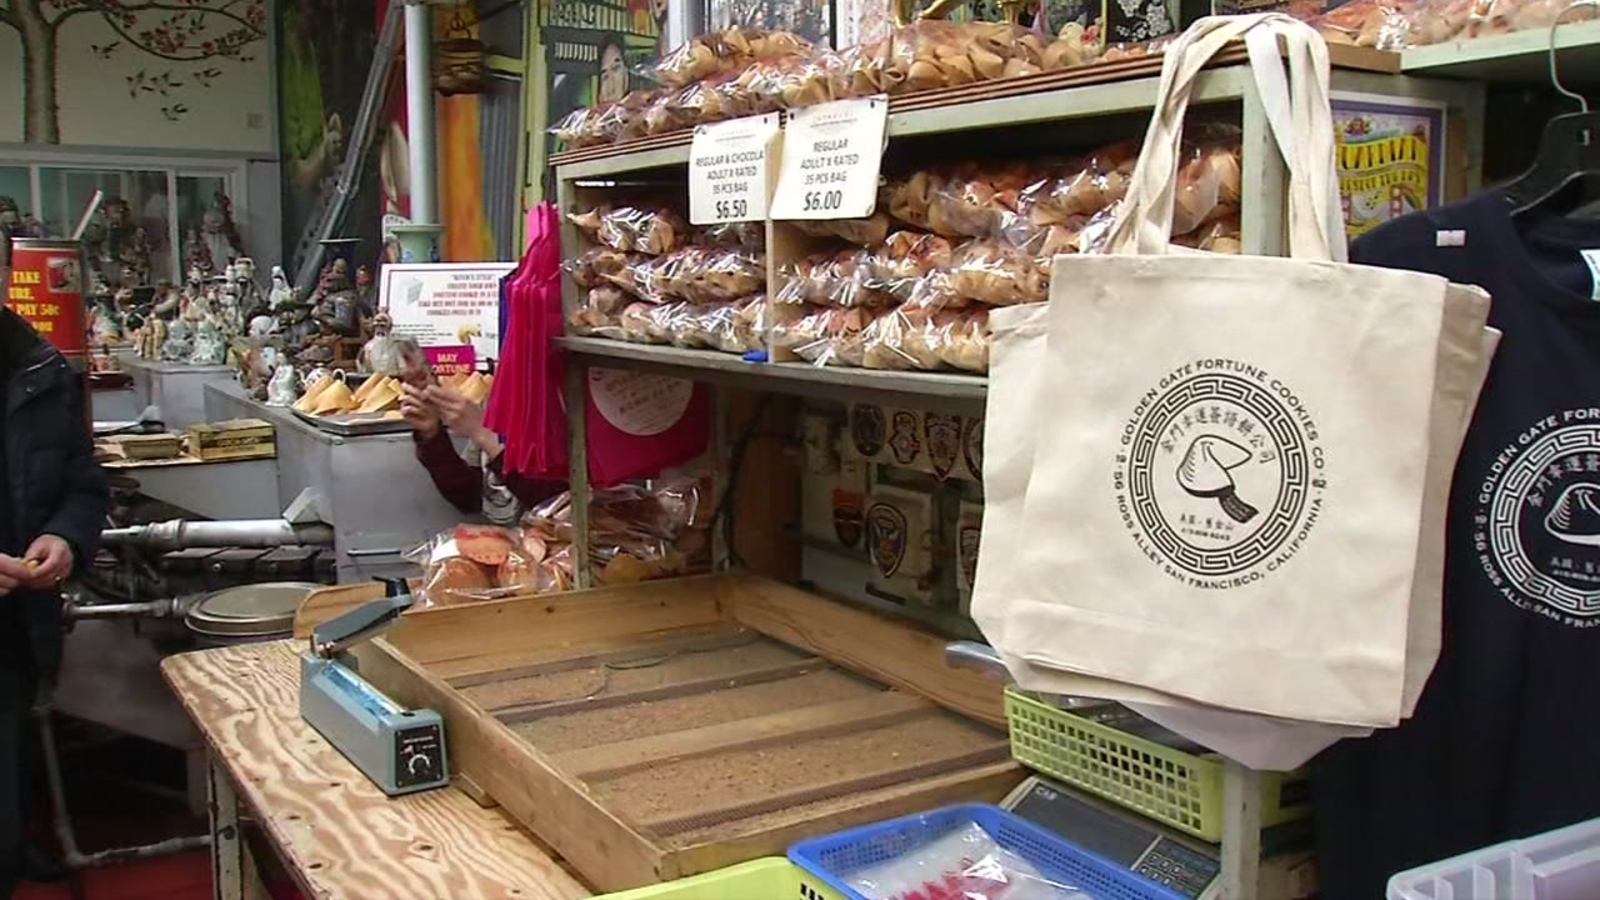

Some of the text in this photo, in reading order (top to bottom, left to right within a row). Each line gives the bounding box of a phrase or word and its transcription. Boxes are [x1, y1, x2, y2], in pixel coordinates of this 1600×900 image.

[813, 138, 848, 153] REGULAR
[696, 154, 724, 167] REGULAR
[731, 150, 764, 163] CHOCOLA
[800, 157, 825, 169] ADULT
[834, 153, 859, 166] RATED
[707, 168, 729, 180] ADULT
[735, 165, 758, 177] RATED
[716, 198, 748, 219] $6.50
[803, 189, 843, 212] $6.00
[13, 270, 41, 284] TAKE
[431, 363, 471, 375] ORTUNE
[1121, 387, 1159, 446] GOLDEN
[1159, 363, 1192, 389] GATE
[1196, 358, 1268, 382] FORTUNE
[1269, 379, 1319, 441] COOKIES
[1478, 408, 1600, 504] GOLDEN GATE FOR
[1117, 494, 1135, 529] ROSS
[1132, 532, 1164, 566] ALLEY
[1164, 564, 1186, 583] SAN
[1188, 570, 1266, 590] FRANCISCO,
[1266, 498, 1324, 572] CALIFORNIA
[1480, 554, 1503, 587] ROSS
[1533, 604, 1560, 621] SAN
[1564, 617, 1600, 629] FRAN
